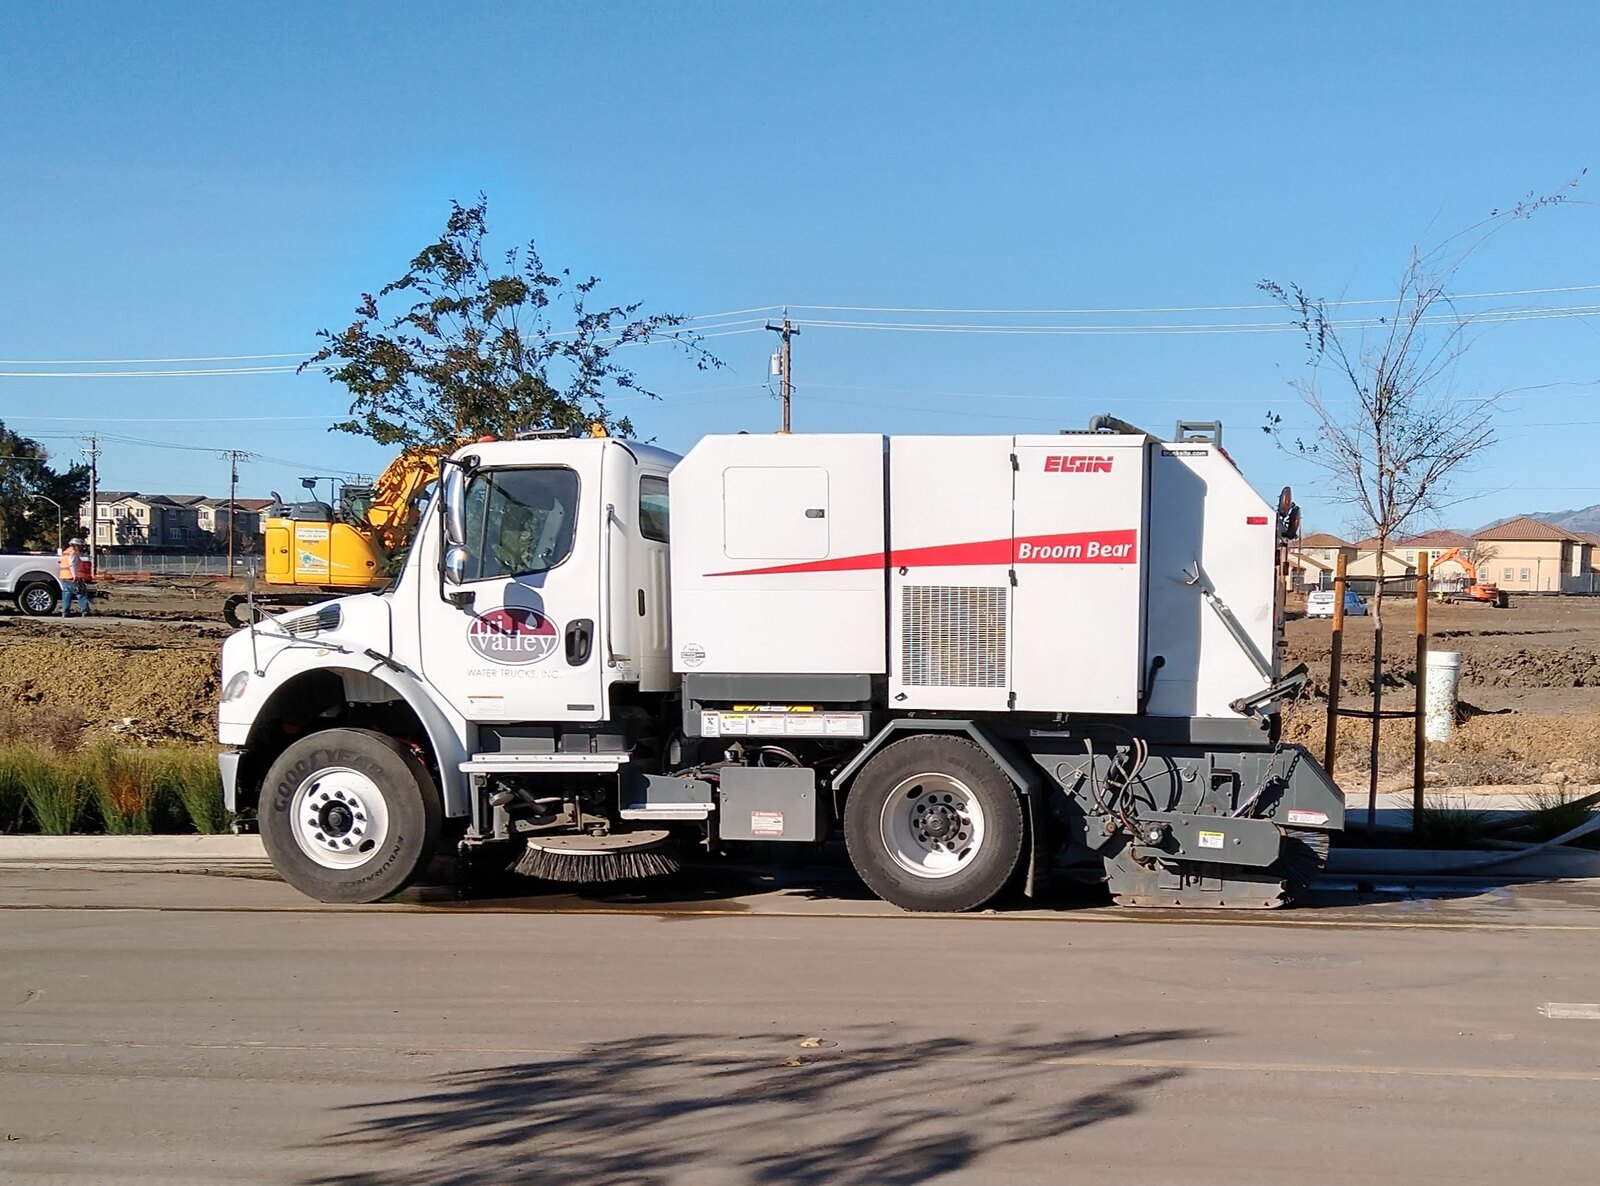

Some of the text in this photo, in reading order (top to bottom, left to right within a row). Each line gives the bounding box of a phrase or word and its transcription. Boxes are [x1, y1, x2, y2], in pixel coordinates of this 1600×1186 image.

[1044, 455, 1114, 473] ELGIN
[1018, 541, 1132, 559] Broom Bear
[476, 614, 504, 635] tri
[474, 629, 556, 657] valley
[467, 668, 498, 678] WATER
[274, 748, 385, 812] GOODYEAR
